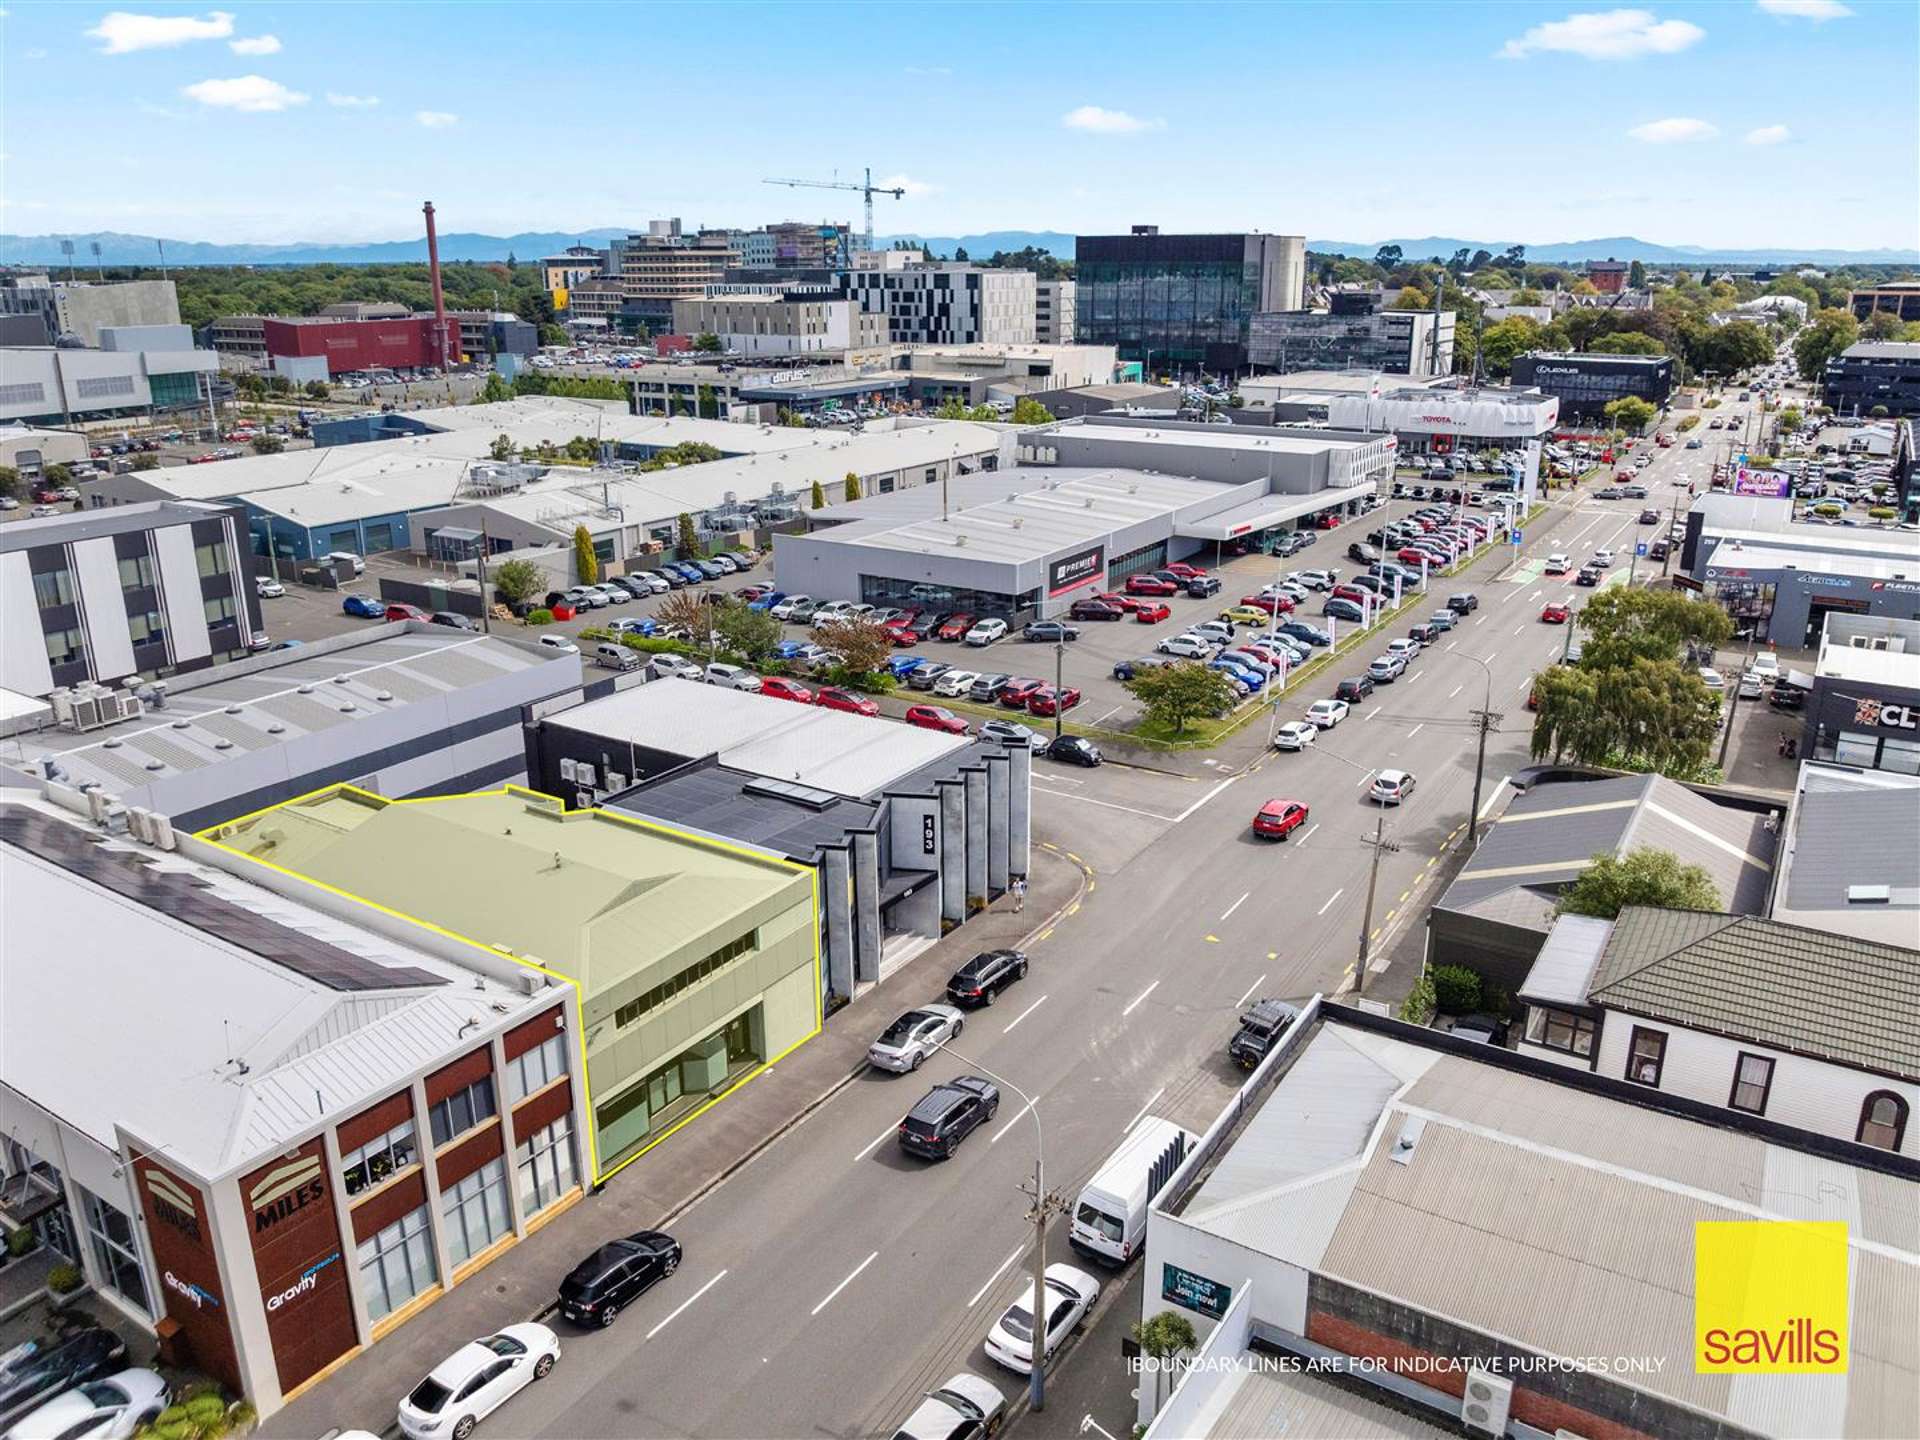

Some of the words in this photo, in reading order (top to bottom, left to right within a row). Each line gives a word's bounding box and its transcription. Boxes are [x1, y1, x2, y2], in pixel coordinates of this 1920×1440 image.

[1067, 553, 1097, 573] PREMIER
[925, 818, 934, 849] 193
[256, 1181, 324, 1233] MILES
[267, 1272, 317, 1311] Gravity
[1176, 1284, 1194, 1298] Join
[1195, 1293, 1218, 1308] now!
